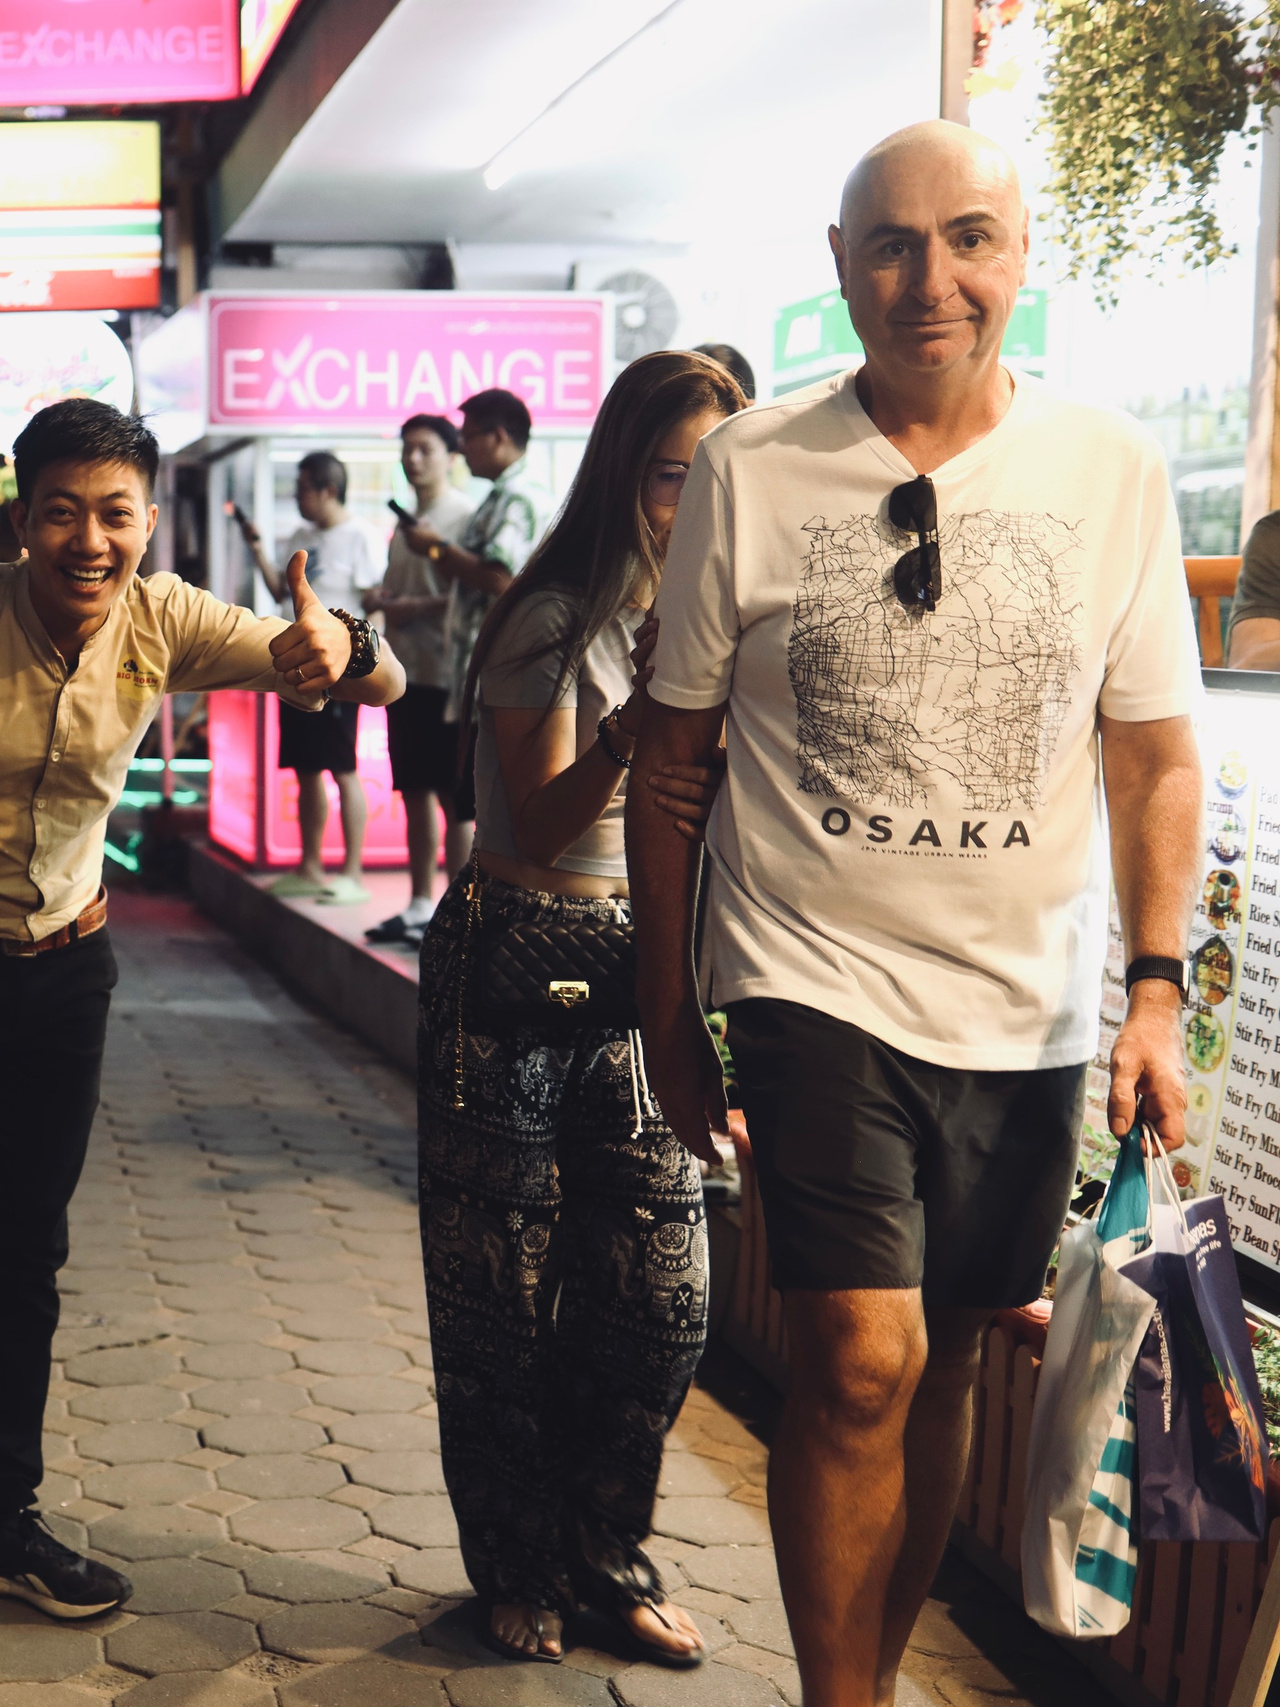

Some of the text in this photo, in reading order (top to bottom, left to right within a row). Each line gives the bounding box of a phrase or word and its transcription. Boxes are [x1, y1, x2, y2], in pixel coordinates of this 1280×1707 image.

[222, 333, 593, 410] EXCHANGE
[133, 675, 159, 685] HORN
[821, 806, 1031, 849] OSAKA
[881, 848, 920, 857] VINTAGE
[1251, 874, 1277, 896] Fried
[1249, 903, 1271, 925] Rice
[1246, 932, 1271, 955] Fried
[1242, 961, 1260, 982] Stir
[1261, 967, 1279, 993] Fry
[1187, 995, 1212, 1017] icken
[1239, 992, 1276, 1024] Stir Fry
[1235, 1022, 1253, 1042] Stir
[1254, 1028, 1272, 1054] Fry
[1230, 1054, 1248, 1075] Stir
[1249, 1061, 1267, 1088] Fry
[1225, 1086, 1243, 1107] Stir
[1244, 1093, 1262, 1119] Fry
[1220, 1116, 1238, 1138] Stir
[1239, 1124, 1257, 1151] Fry
[1214, 1144, 1232, 1166] Stir
[1233, 1153, 1252, 1180] Fry
[1208, 1175, 1227, 1198] Stir
[1228, 1184, 1247, 1212] Fry
[1242, 1224, 1269, 1253] Bean
